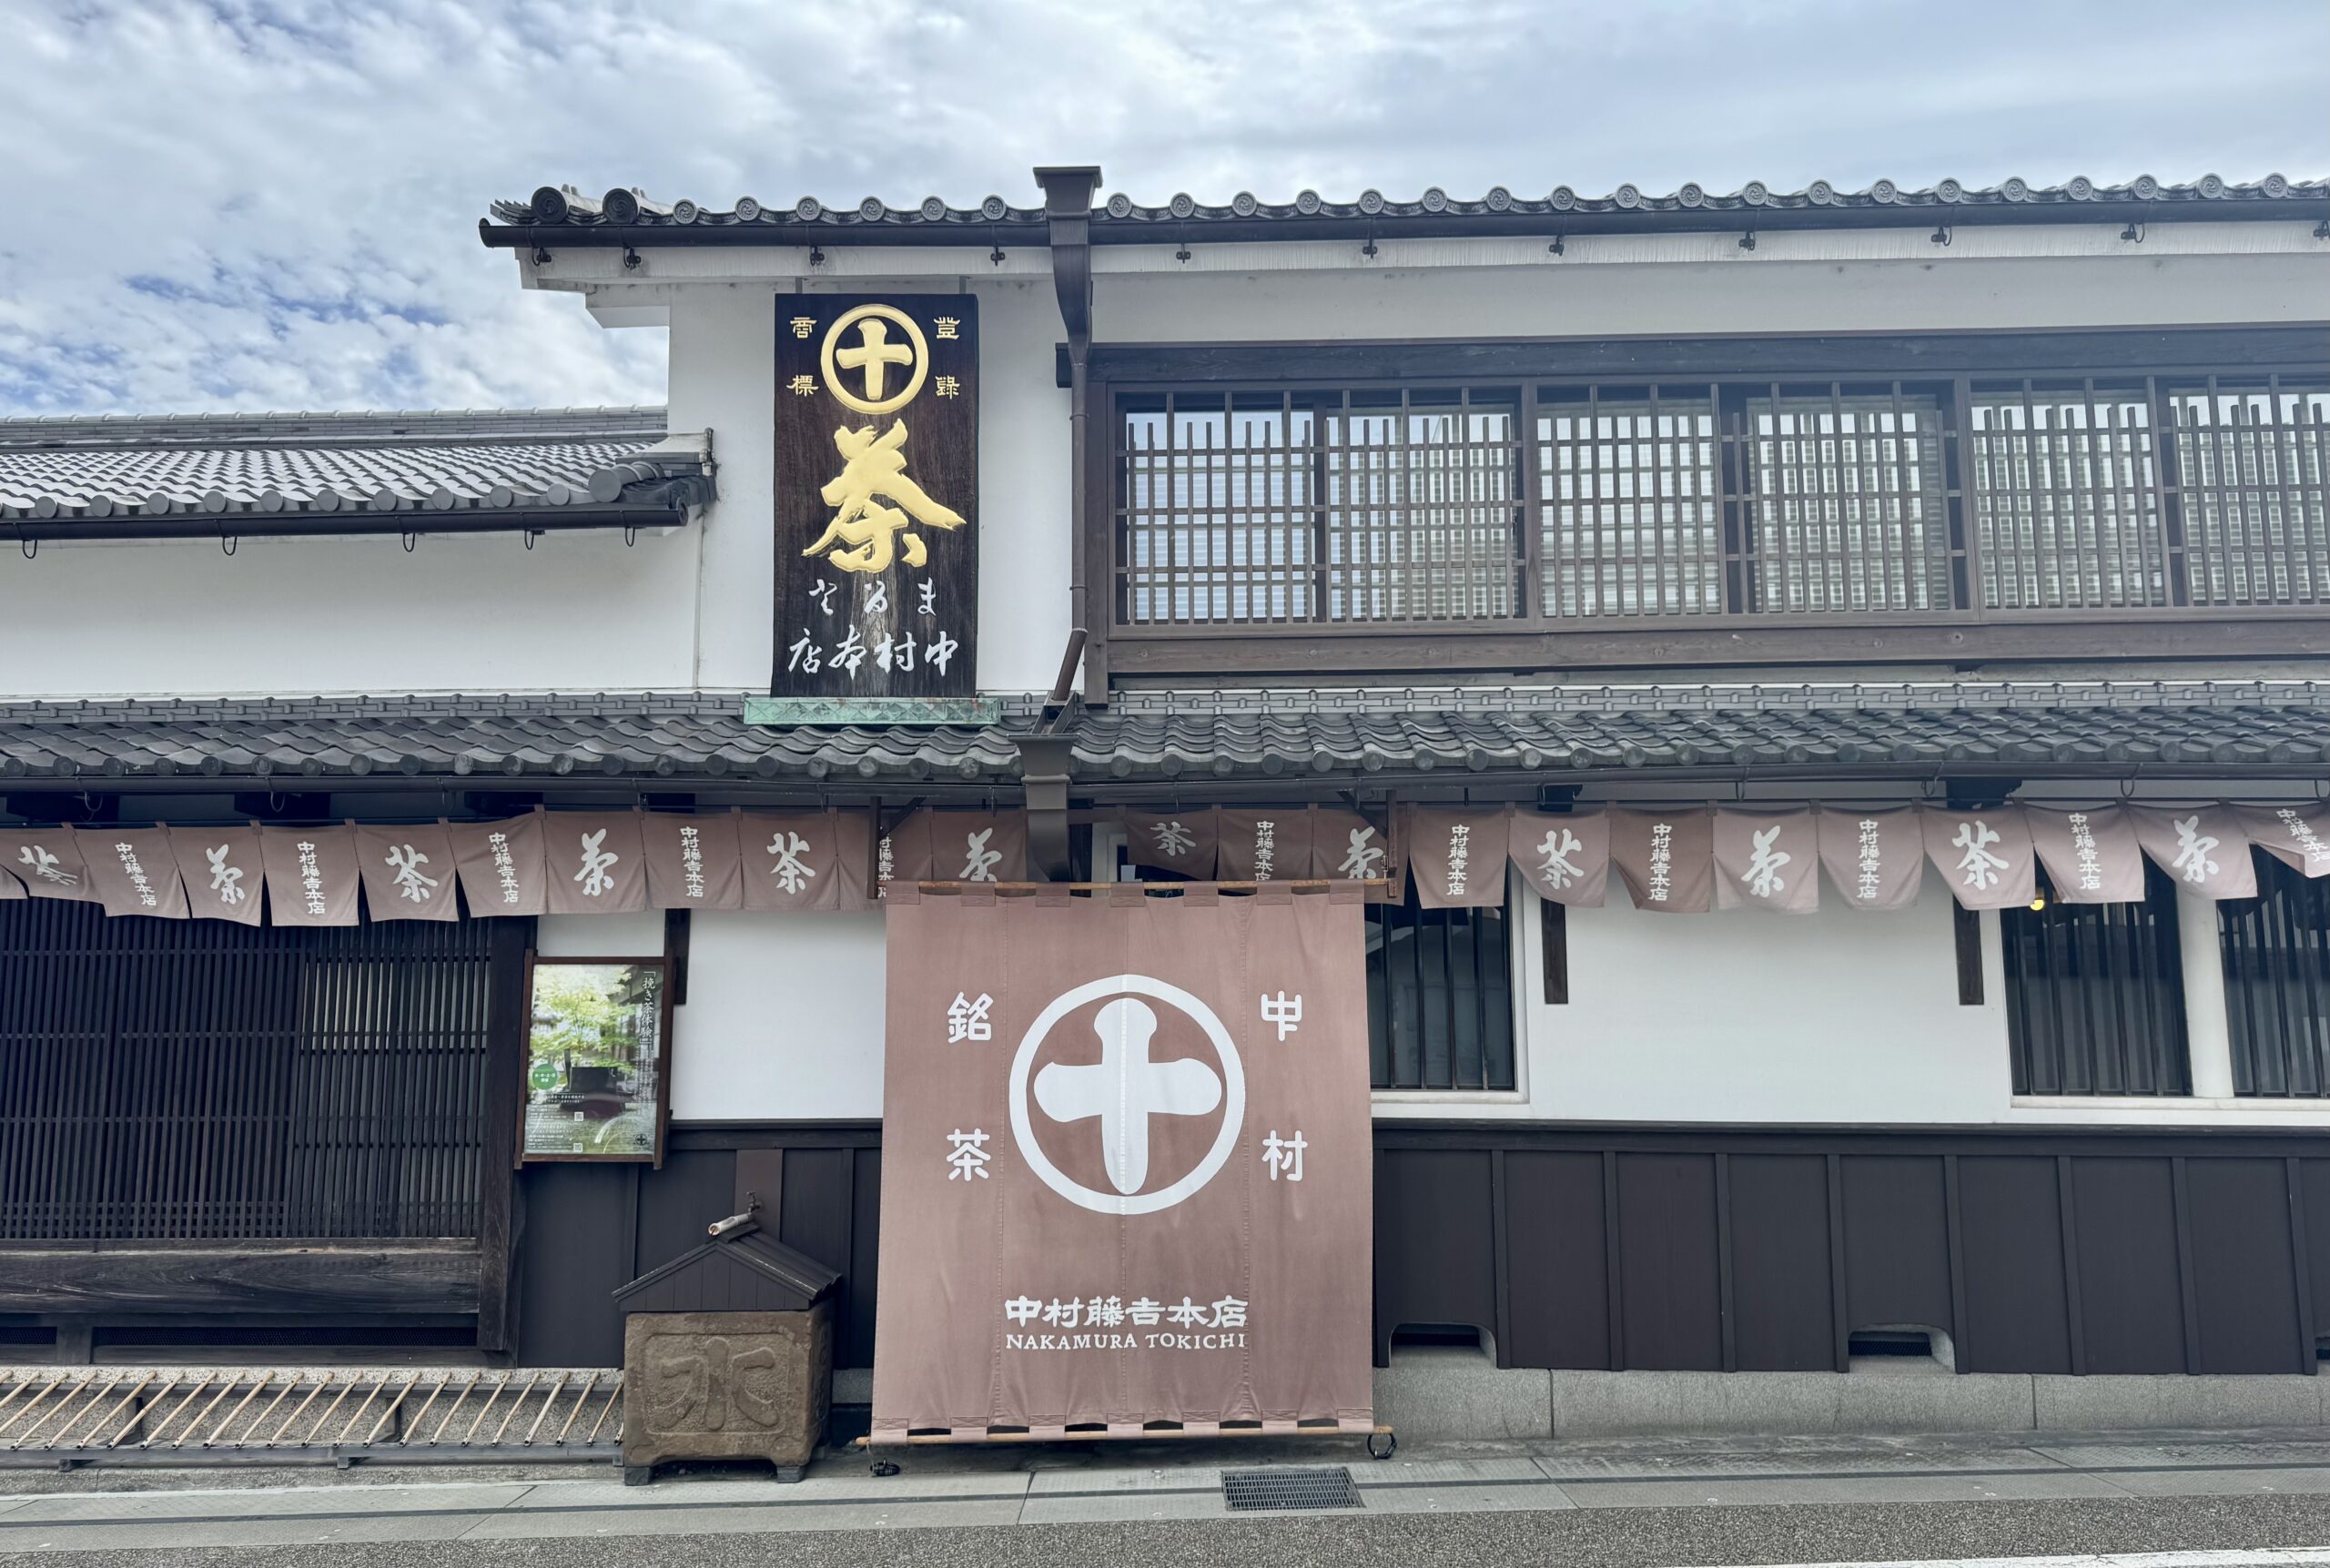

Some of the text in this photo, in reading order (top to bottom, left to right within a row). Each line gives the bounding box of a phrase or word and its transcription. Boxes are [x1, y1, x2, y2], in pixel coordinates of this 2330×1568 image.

[802, 418, 967, 574] 茶
[574, 829, 618, 896] 茶
[767, 832, 816, 895] 茶
[1150, 822, 1196, 855] 茶
[1537, 829, 1584, 889] 茶
[1741, 826, 1791, 897] 茶
[1952, 820, 2010, 890] 茶
[2172, 815, 2219, 883] 茶
[206, 844, 246, 905] 茶
[386, 845, 438, 903] 茶
[1005, 1295, 1248, 1329] 中村藤吉本店
[1006, 1333, 1245, 1350] NAKAMURA TOKICHI
